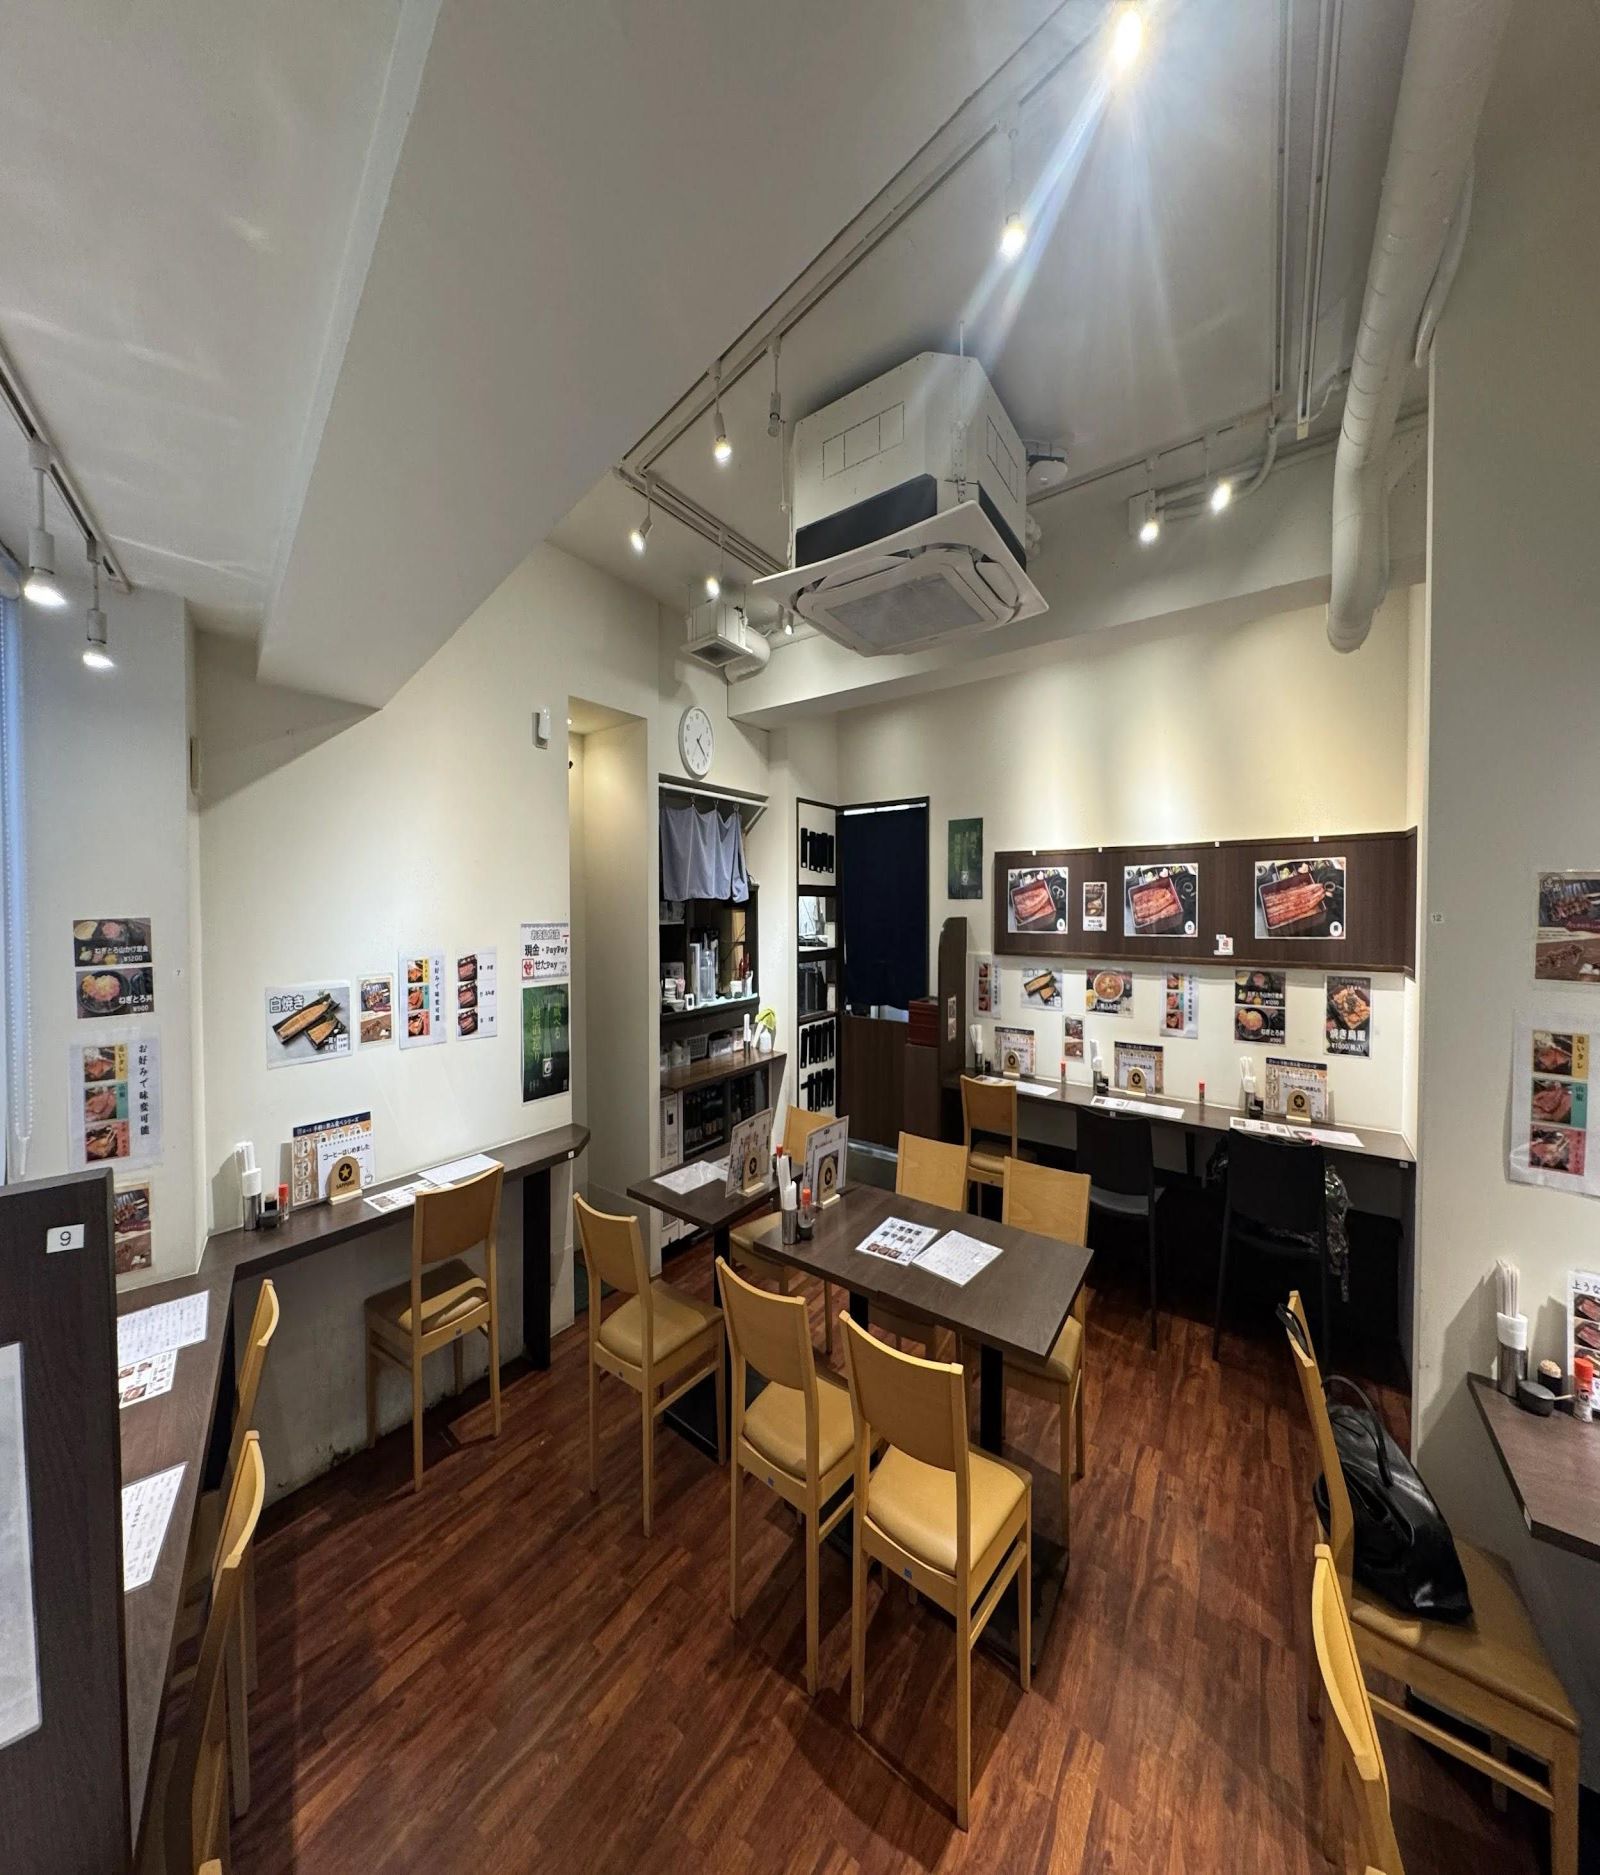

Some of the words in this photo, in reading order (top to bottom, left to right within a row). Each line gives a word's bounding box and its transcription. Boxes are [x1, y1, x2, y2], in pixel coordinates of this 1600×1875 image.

[269, 994, 305, 1014] 白焼き
[60, 1231, 72, 1247] 9
